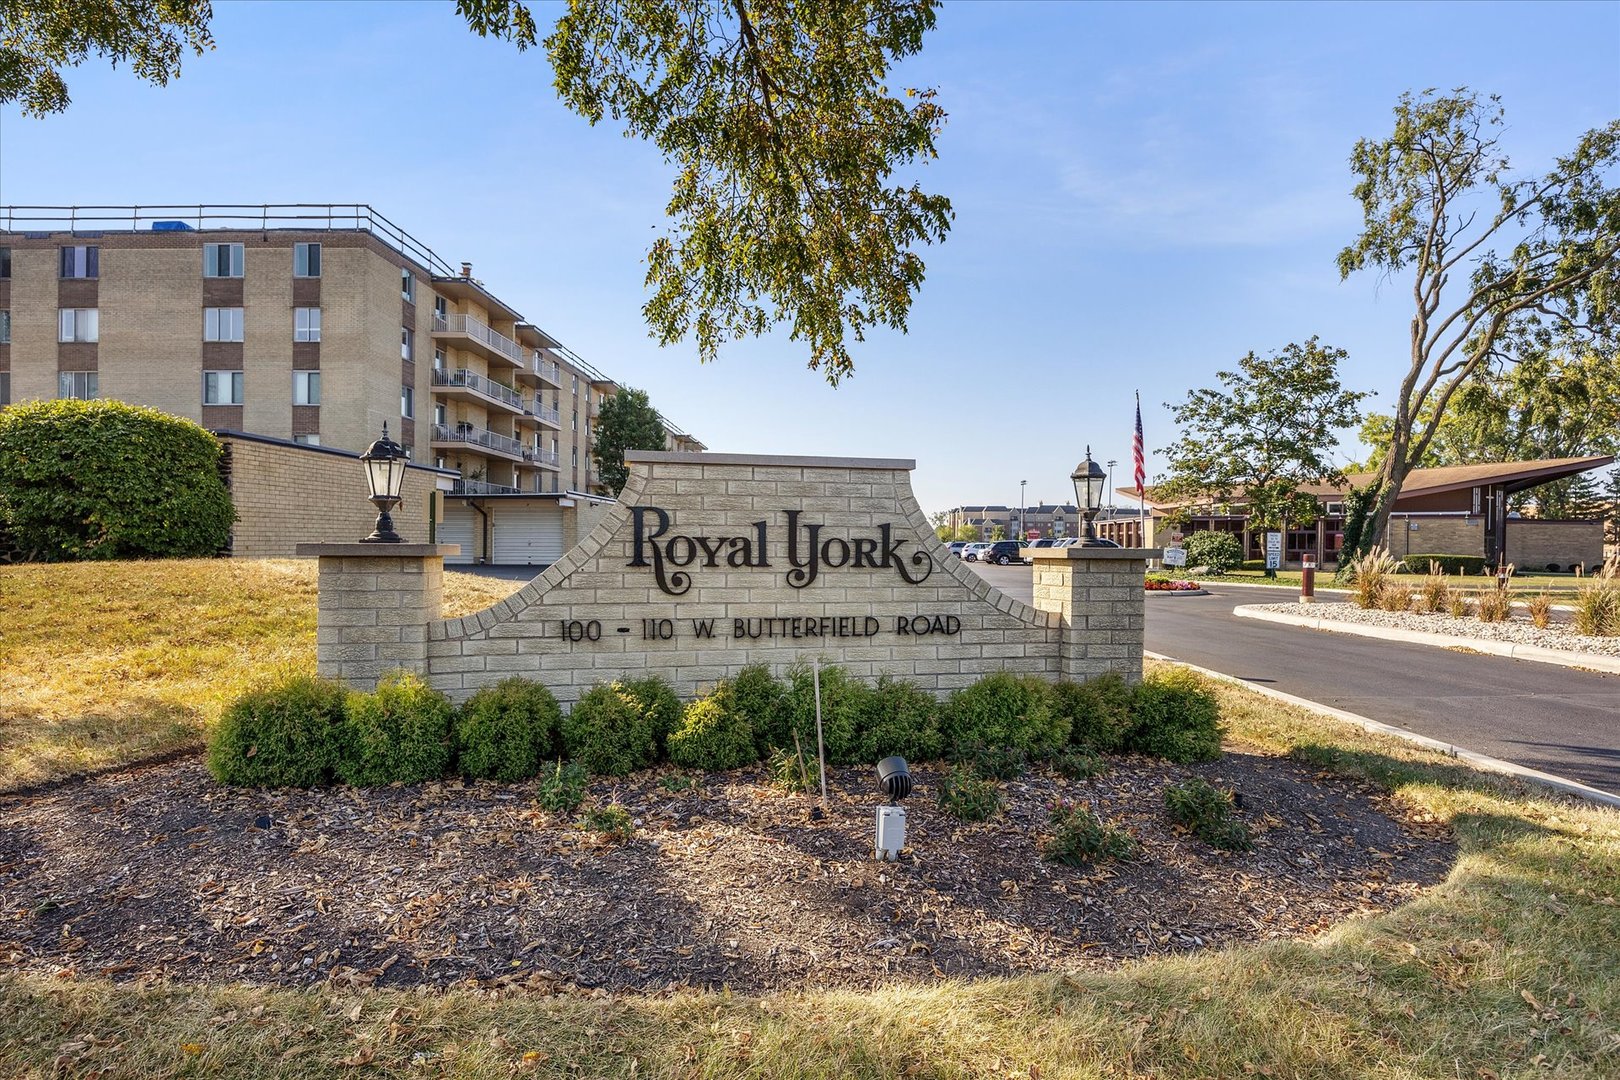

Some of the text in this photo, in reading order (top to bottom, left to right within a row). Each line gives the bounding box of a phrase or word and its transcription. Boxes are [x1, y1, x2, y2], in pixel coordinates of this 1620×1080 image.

[625, 505, 933, 596] Royal York
[1269, 560, 1278, 568] 15
[560, 619, 602, 642] 100
[642, 618, 674, 641] 110
[692, 618, 716, 639] W.
[733, 616, 880, 639] BUTTERFIELD
[897, 615, 961, 636] ROAD
